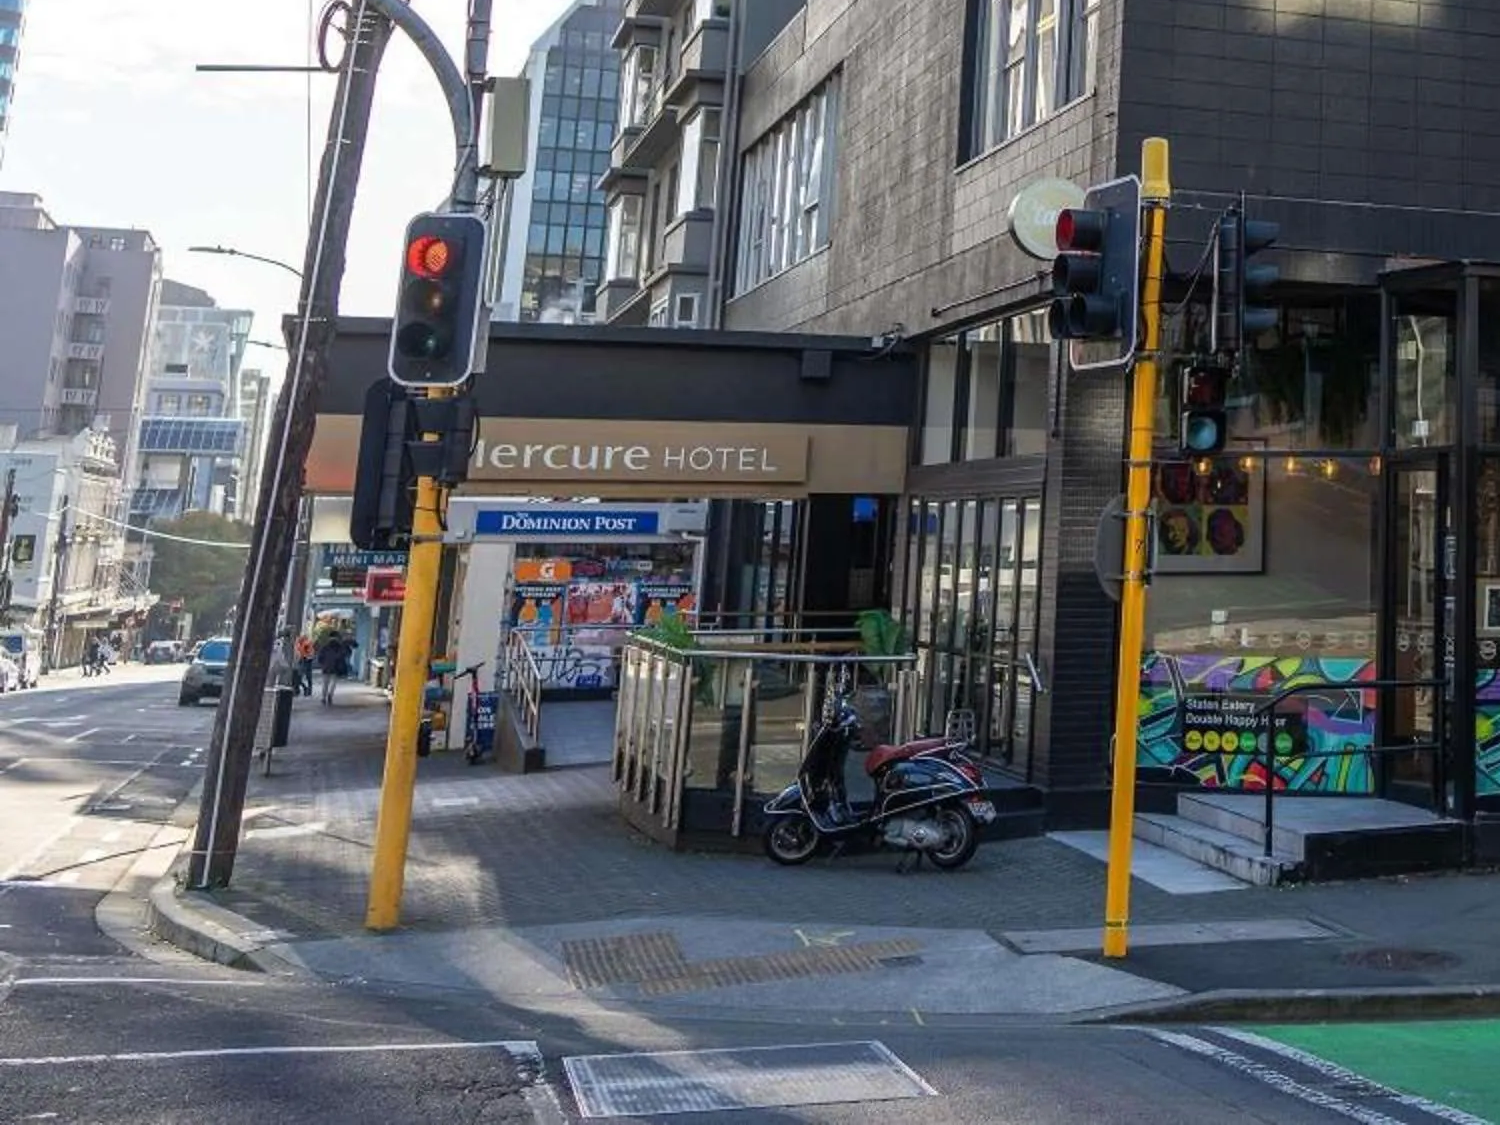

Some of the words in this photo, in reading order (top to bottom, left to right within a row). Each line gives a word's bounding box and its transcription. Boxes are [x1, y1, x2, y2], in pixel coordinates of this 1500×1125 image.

[663, 447, 778, 473] HOTEL
[501, 513, 592, 531] DOMINION
[595, 517, 637, 531] POST
[333, 554, 368, 565] MINI
[373, 554, 408, 565] MAR
[1185, 698, 1219, 710] Staten
[1221, 699, 1255, 713] Eatery
[1185, 713, 1223, 724] Double
[1225, 714, 1258, 727] Happy
